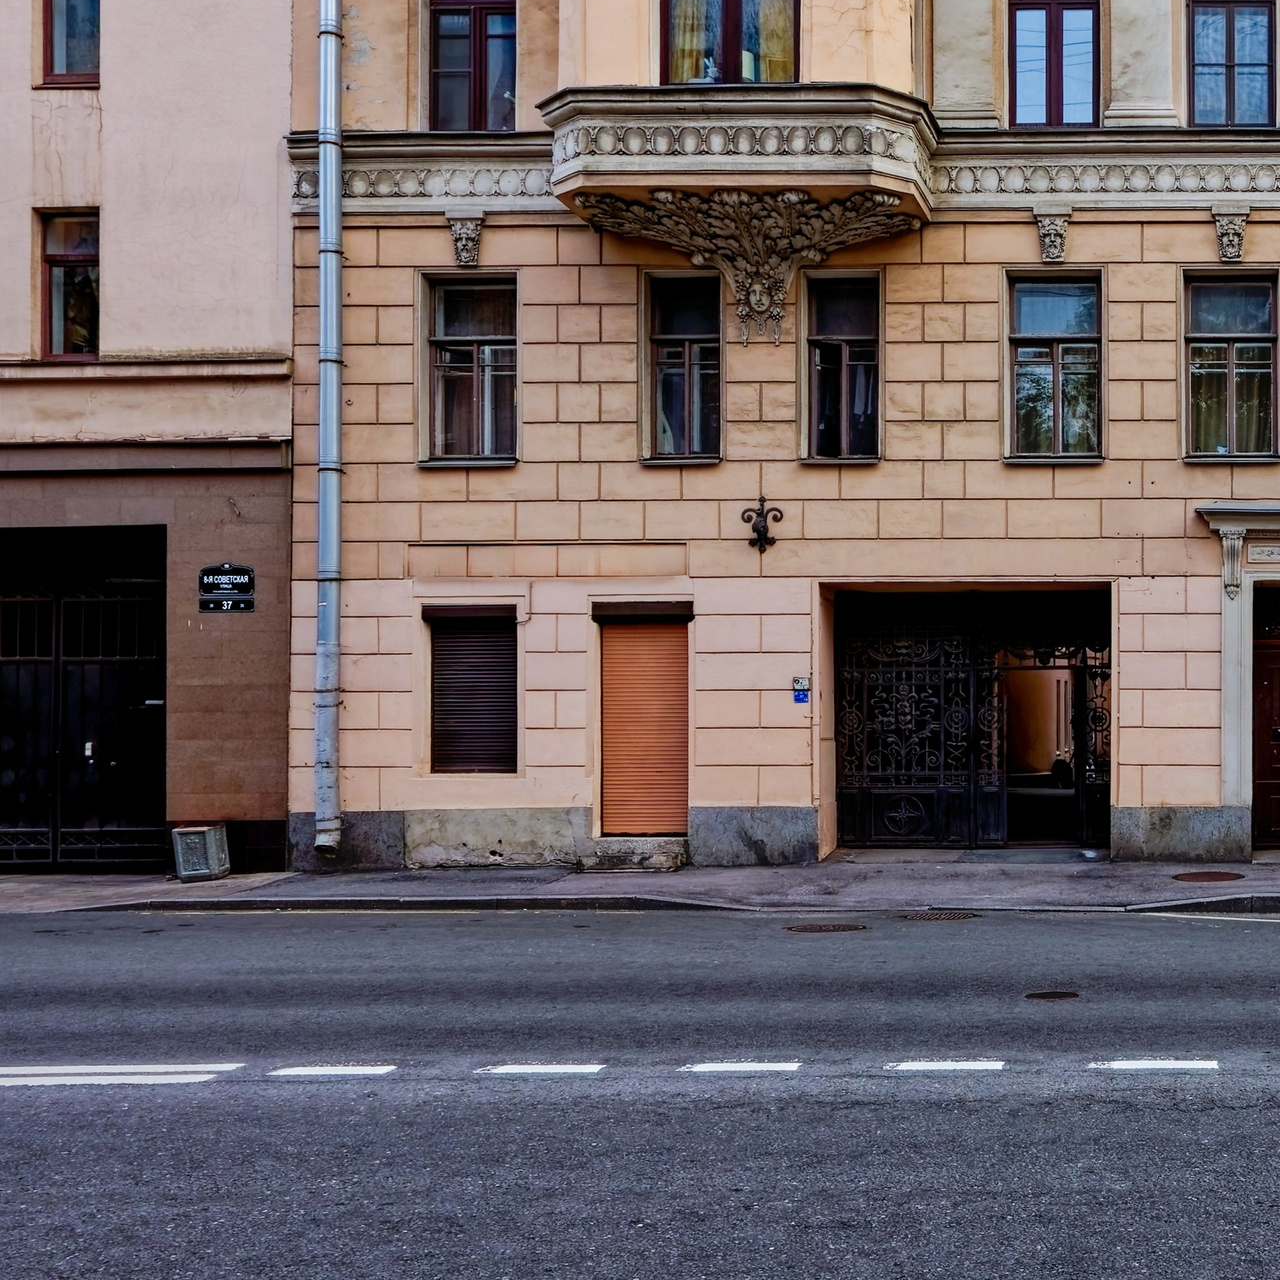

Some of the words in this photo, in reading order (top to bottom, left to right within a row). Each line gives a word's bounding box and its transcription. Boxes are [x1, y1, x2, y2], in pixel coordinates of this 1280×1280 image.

[203, 575, 213, 583] 8-Я
[214, 575, 249, 583] СОВЕТСКАЯ
[222, 600, 233, 610] 37
